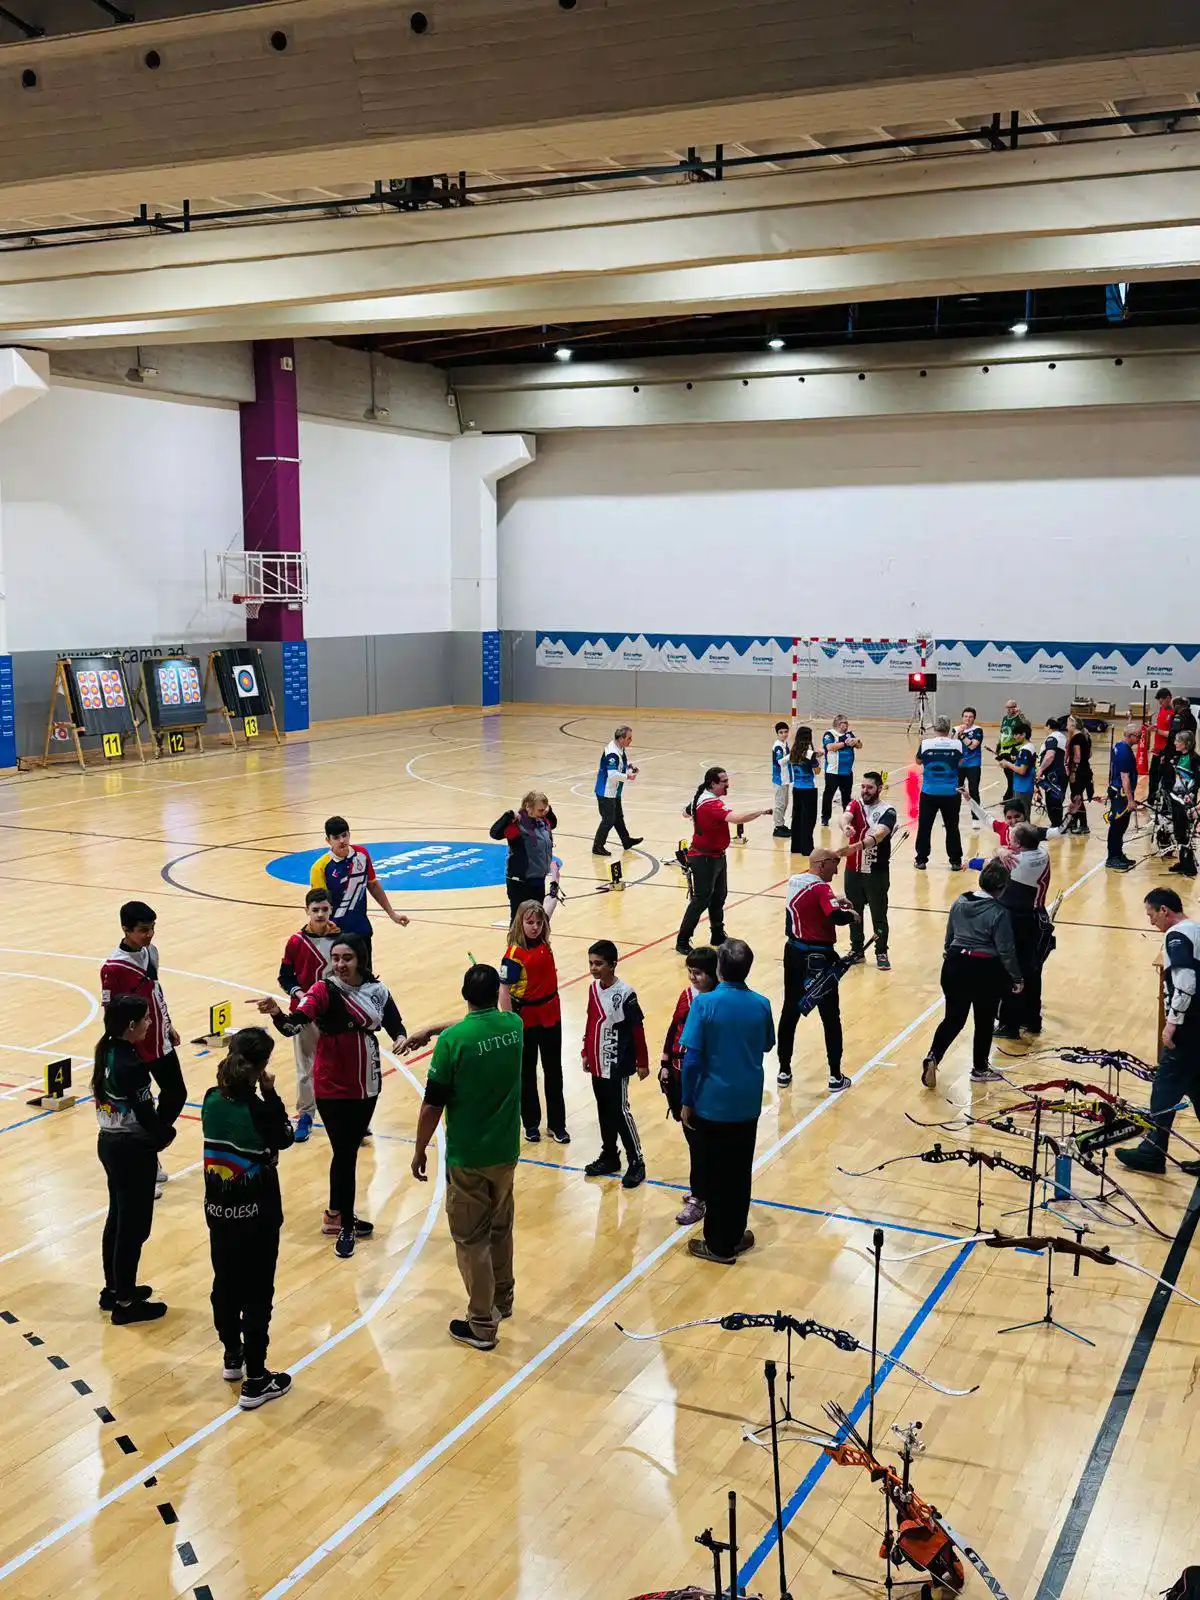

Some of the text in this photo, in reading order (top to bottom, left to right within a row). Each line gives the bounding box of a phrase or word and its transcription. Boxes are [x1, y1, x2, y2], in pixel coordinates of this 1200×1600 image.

[987, 661, 1012, 669] Encamp
[1132, 680, 1159, 689] A B
[246, 719, 257, 735] 13
[105, 736, 121, 755] 11
[170, 735, 184, 752] 12
[218, 1008, 226, 1025] 5
[477, 1030, 520, 1056] JUTGE
[603, 1028, 619, 1066] TAE
[54, 1065, 63, 1085] 4
[224, 1202, 259, 1219] OLESA
[963, 1547, 1009, 1600] GRAV
